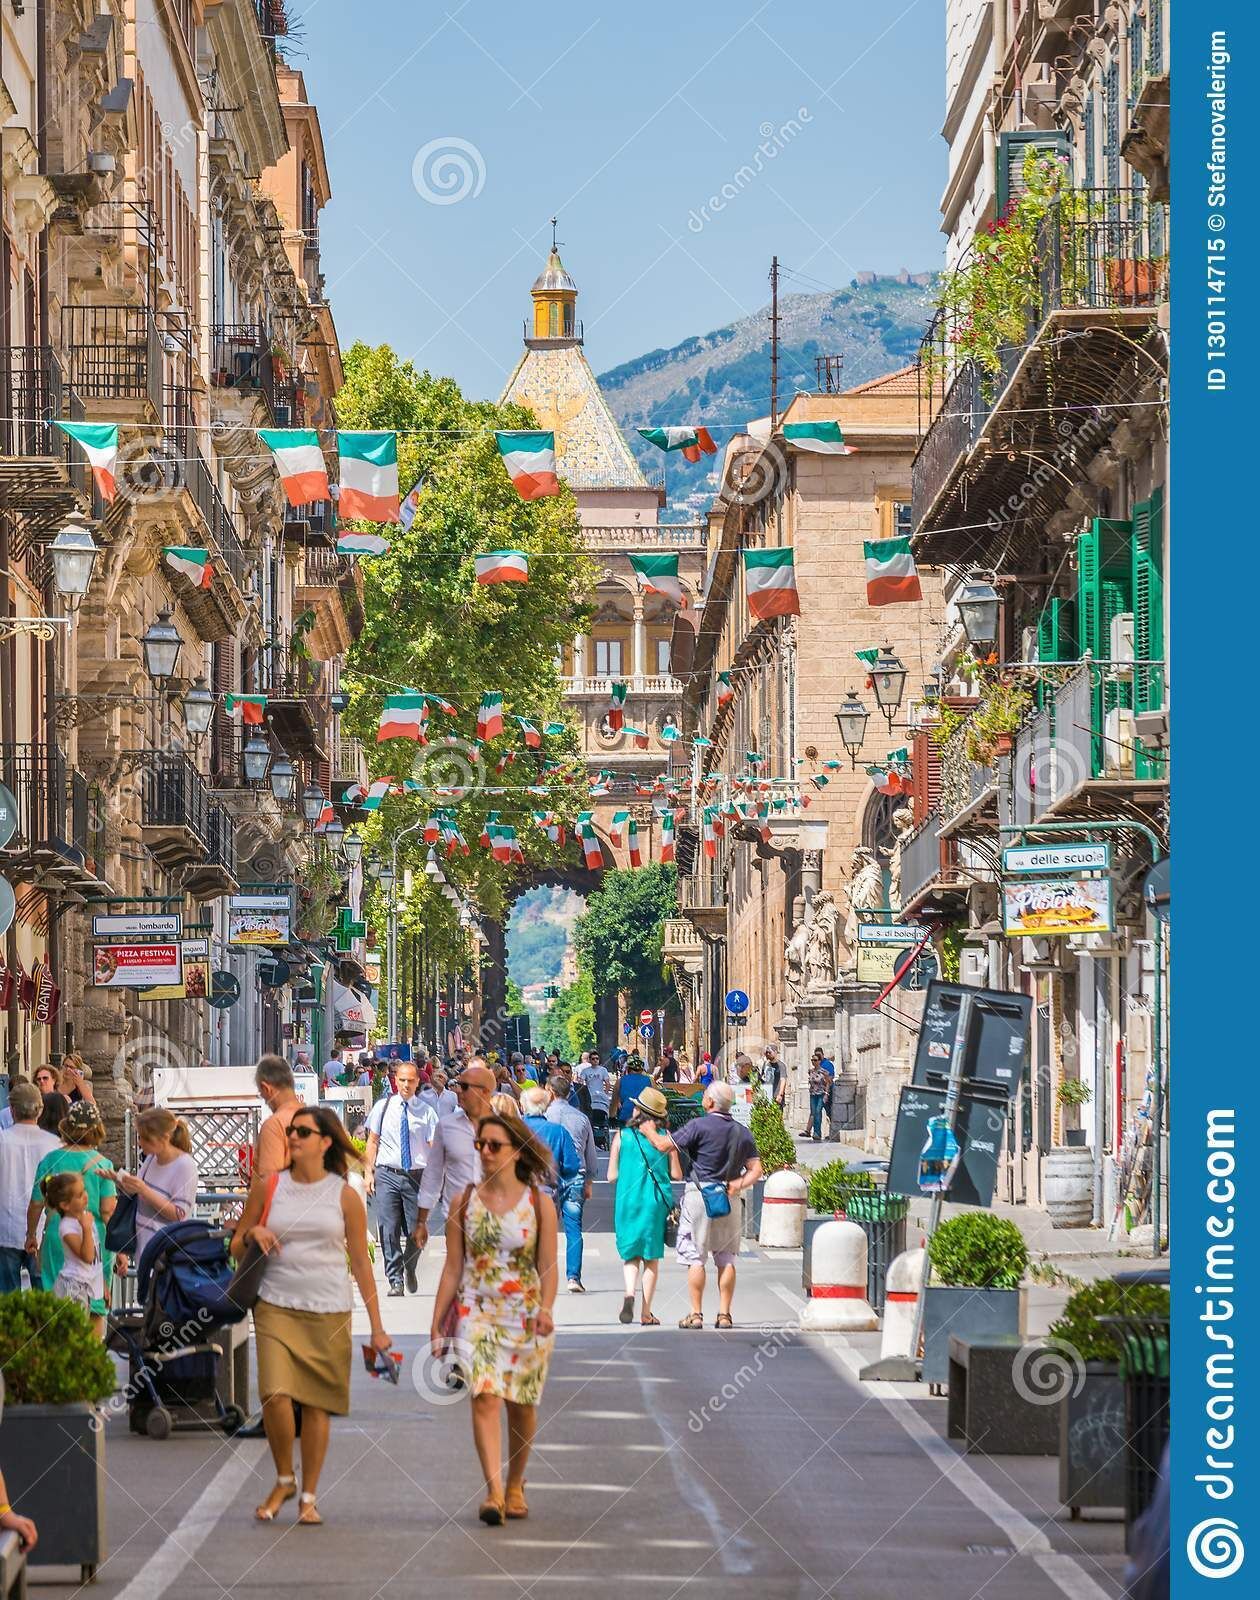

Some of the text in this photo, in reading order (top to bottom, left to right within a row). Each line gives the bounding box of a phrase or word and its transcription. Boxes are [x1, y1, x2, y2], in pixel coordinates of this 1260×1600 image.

[1030, 854, 1060, 865] delle
[139, 922, 174, 930] lombardo
[116, 949, 175, 958] PIZZA FESTIVAL
